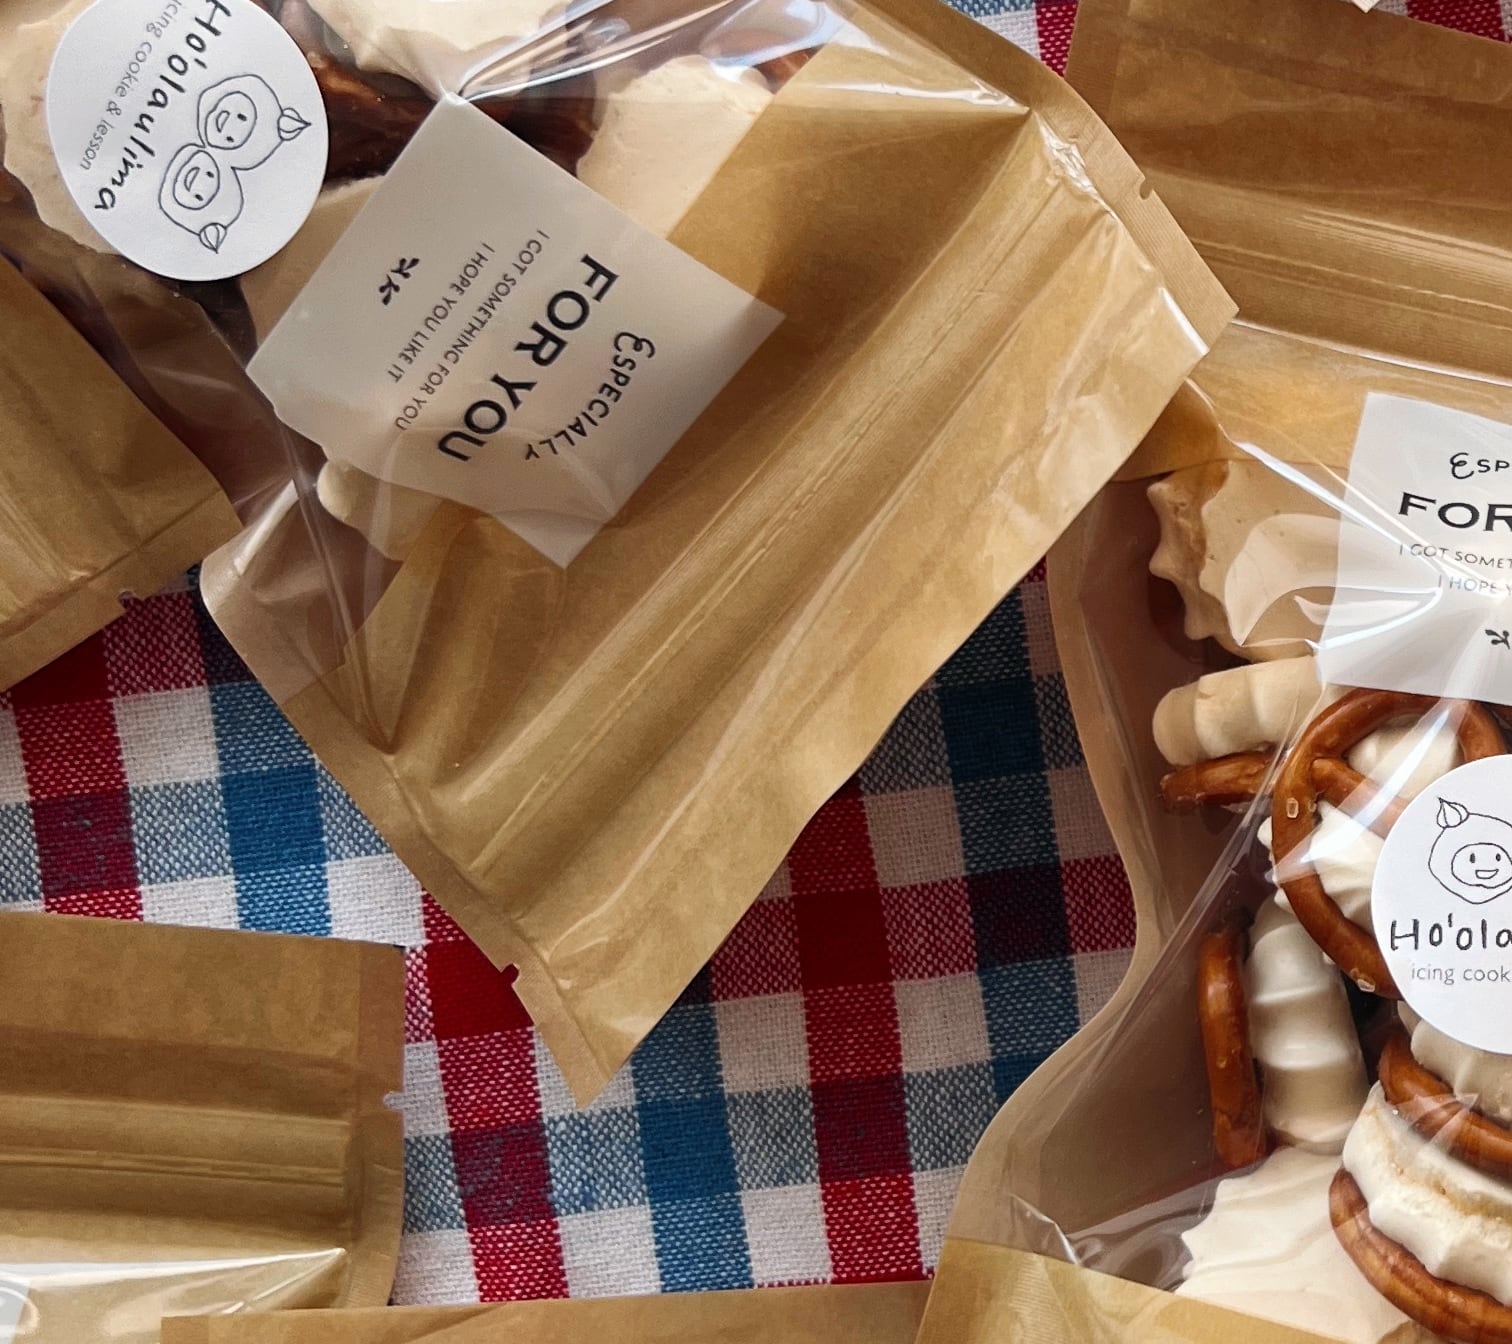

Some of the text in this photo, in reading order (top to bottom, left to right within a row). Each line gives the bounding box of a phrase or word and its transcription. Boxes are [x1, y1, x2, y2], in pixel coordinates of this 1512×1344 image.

[116, 41, 153, 97] cookie
[106, 101, 122, 116] &
[80, 117, 115, 171] lesson
[449, 253, 488, 295] HOPE
[515, 238, 543, 275] GOT
[424, 297, 457, 335] YOU
[451, 274, 517, 363] SOMETHING
[399, 335, 430, 364] LIKE
[438, 254, 619, 461] FOR YOU
[388, 366, 403, 383] IT
[421, 364, 449, 395] FOR
[525, 331, 655, 461] ESPECIALLY
[395, 398, 423, 431] YOU
[1410, 544, 1447, 558] GOT
[1449, 576, 1498, 594] HOPE
[1411, 963, 1454, 985] icing
